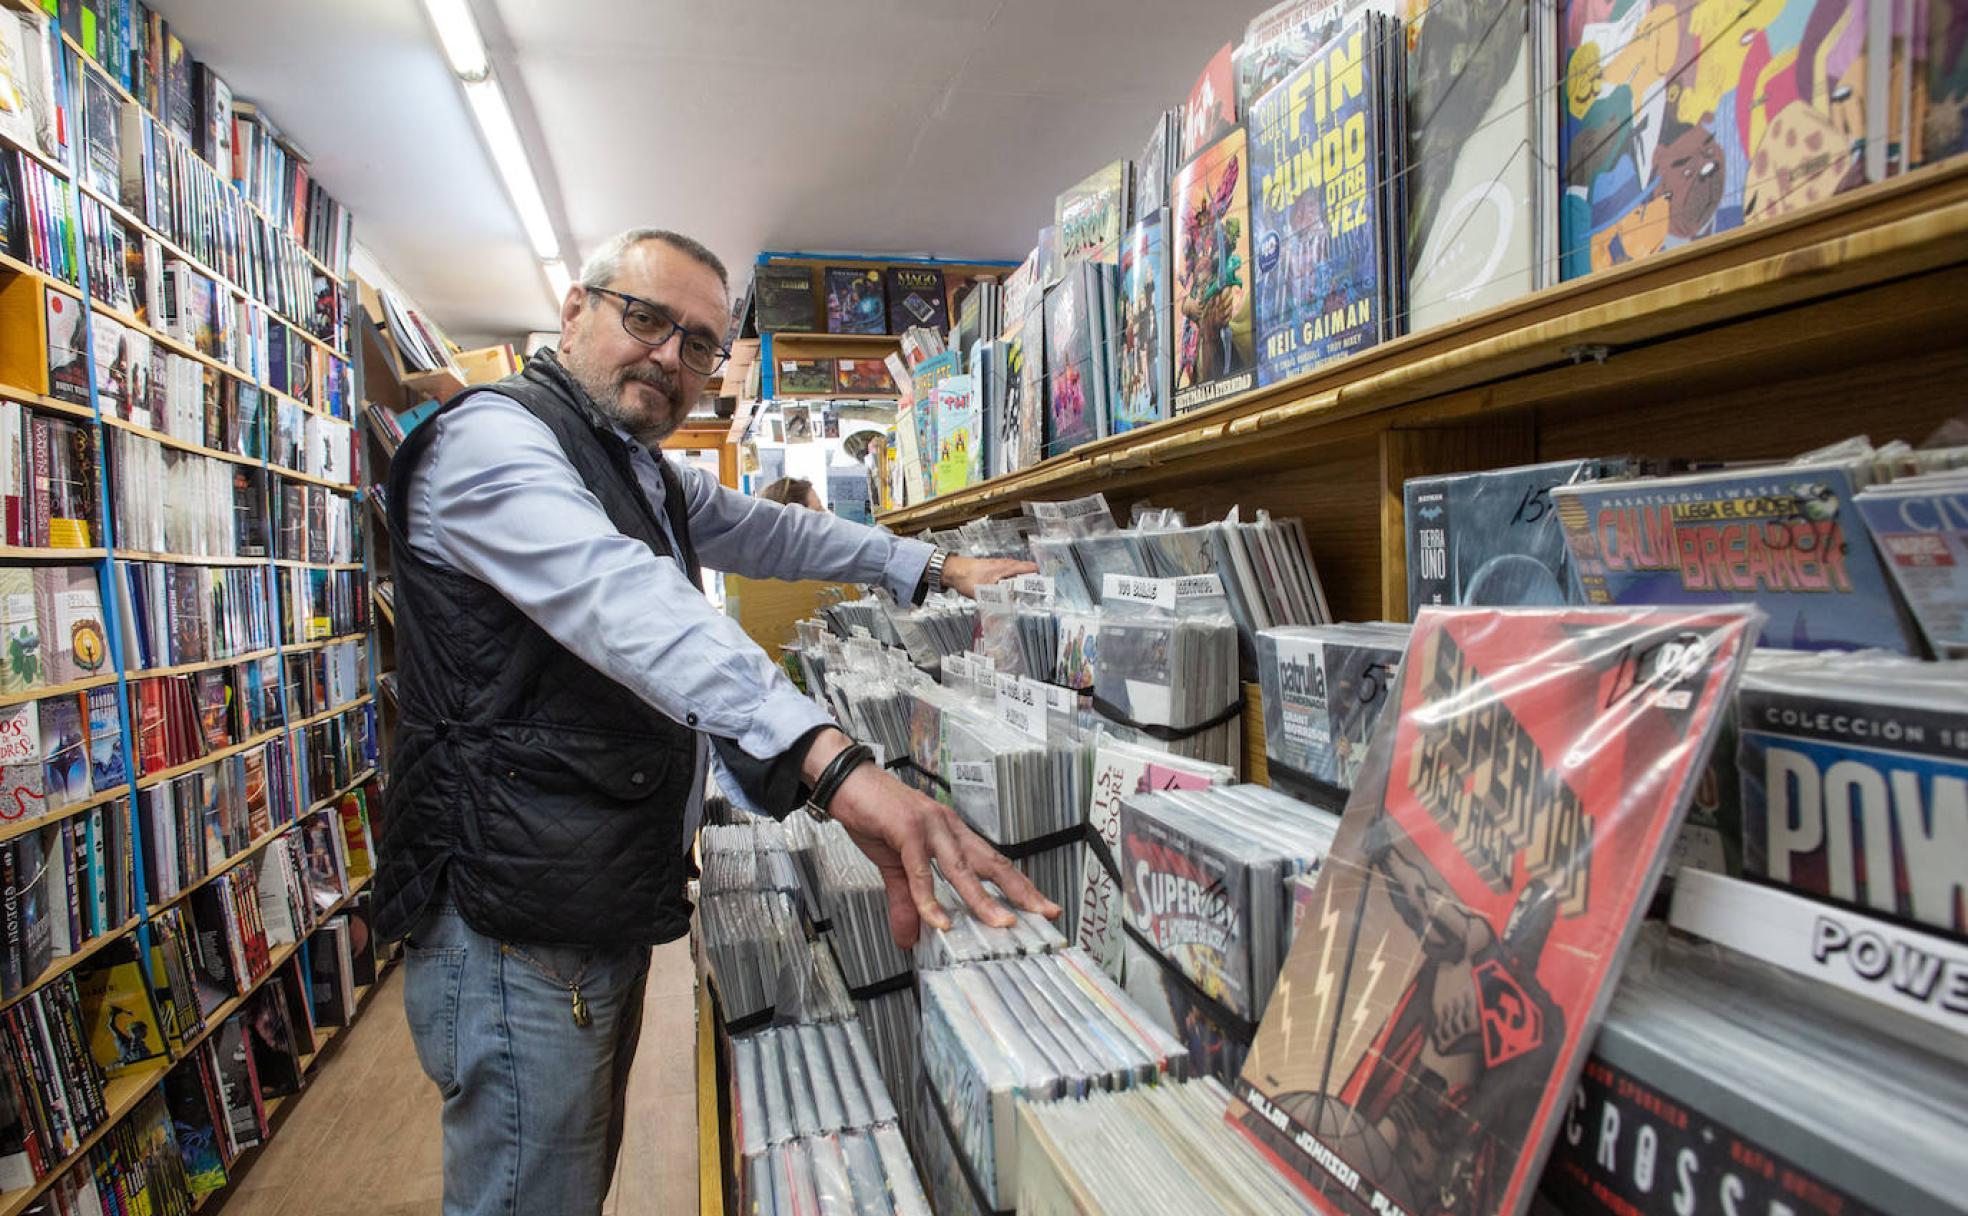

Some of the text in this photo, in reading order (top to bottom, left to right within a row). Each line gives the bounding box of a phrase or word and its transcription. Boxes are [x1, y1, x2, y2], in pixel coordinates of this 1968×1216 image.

[1289, 31, 1364, 142] FIN
[1261, 111, 1366, 213] MUNDO
[1326, 163, 1366, 207] OTRA
[1328, 188, 1368, 239] VEZ
[1267, 298, 1370, 360] NEIL GAIMAN
[1420, 529, 1445, 550] TIERRA
[1421, 549, 1446, 580] UNO
[1598, 503, 1682, 571] CALM
[1676, 520, 1853, 593] BREAKER
[1281, 653, 1325, 698] patrulla
[1765, 707, 1924, 743] COLECCIÓN
[4, 886, 19, 945] GIDEON
[1566, 1085, 1795, 1216] CROSS
